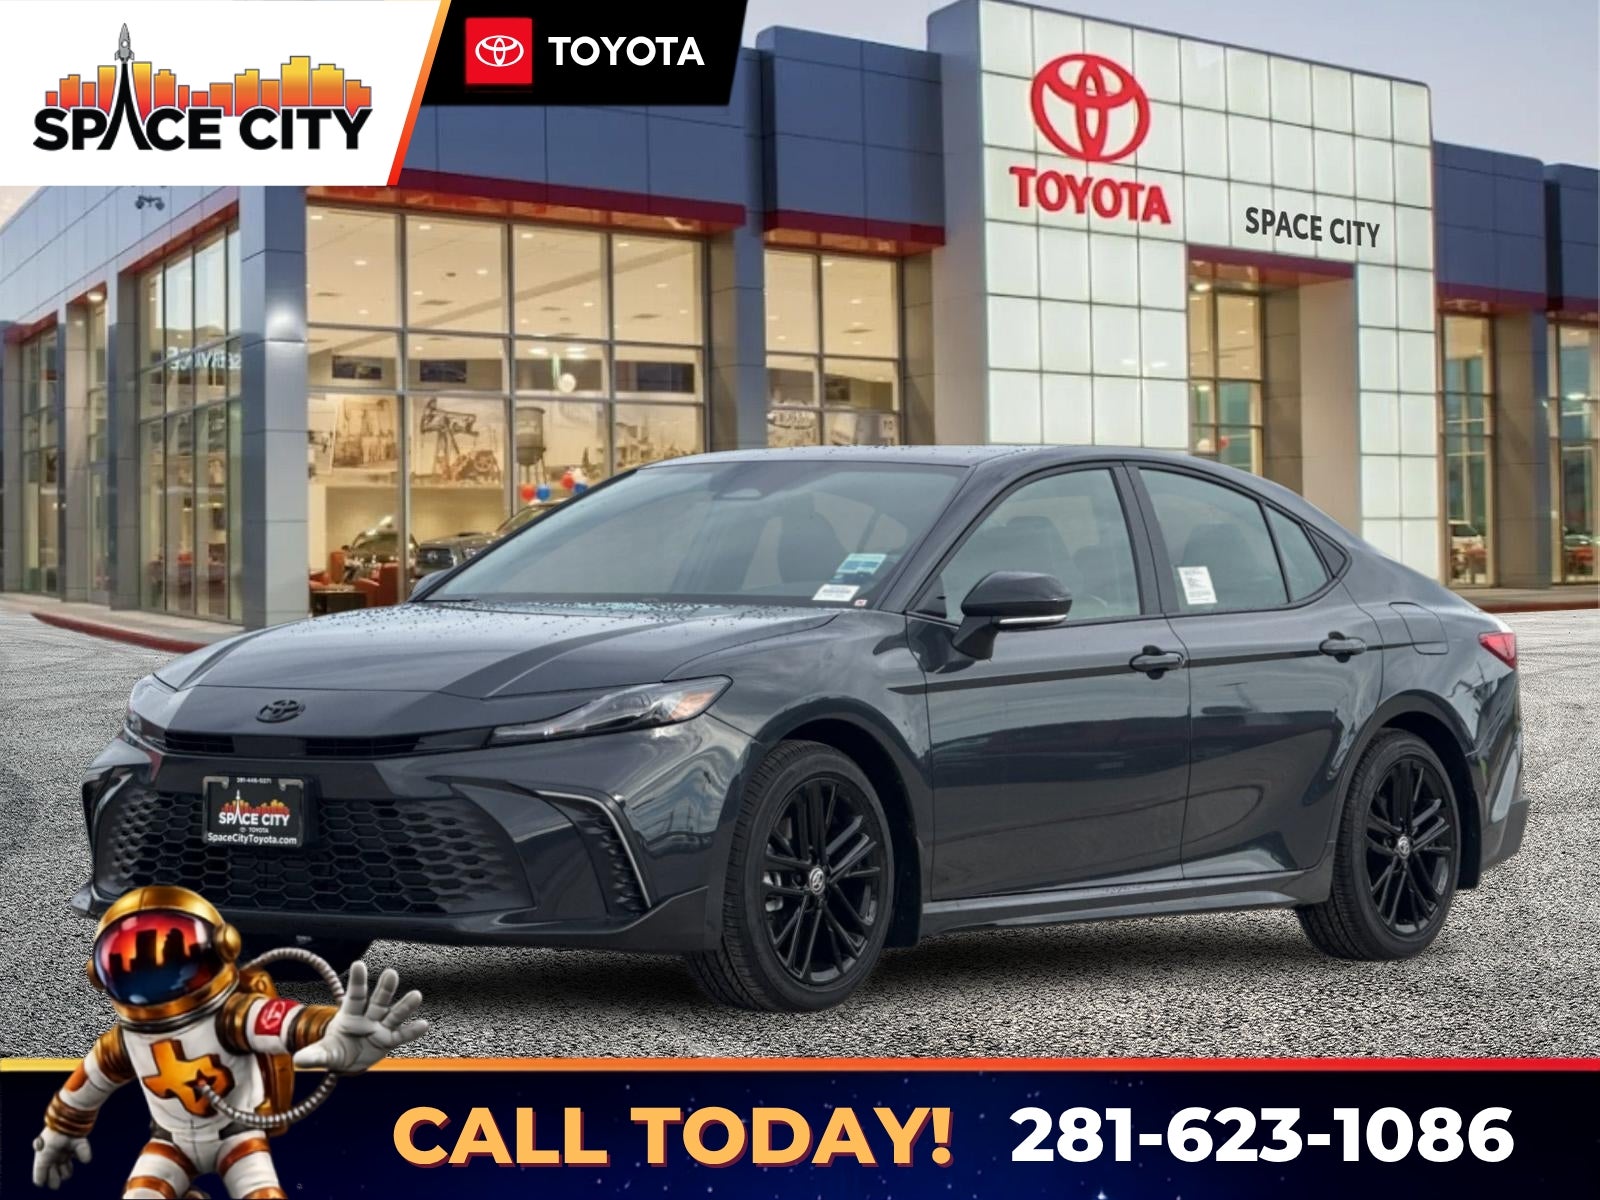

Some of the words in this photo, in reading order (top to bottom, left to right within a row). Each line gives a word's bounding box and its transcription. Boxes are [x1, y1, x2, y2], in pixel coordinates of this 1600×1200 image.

[1009, 165, 1171, 225] TOYOTA
[1244, 206, 1324, 242] SPACE
[1330, 217, 1382, 249] CITY
[218, 811, 259, 825] SPACE
[261, 813, 290, 826] CITY
[207, 832, 297, 844] SpaceCityToyota.com
